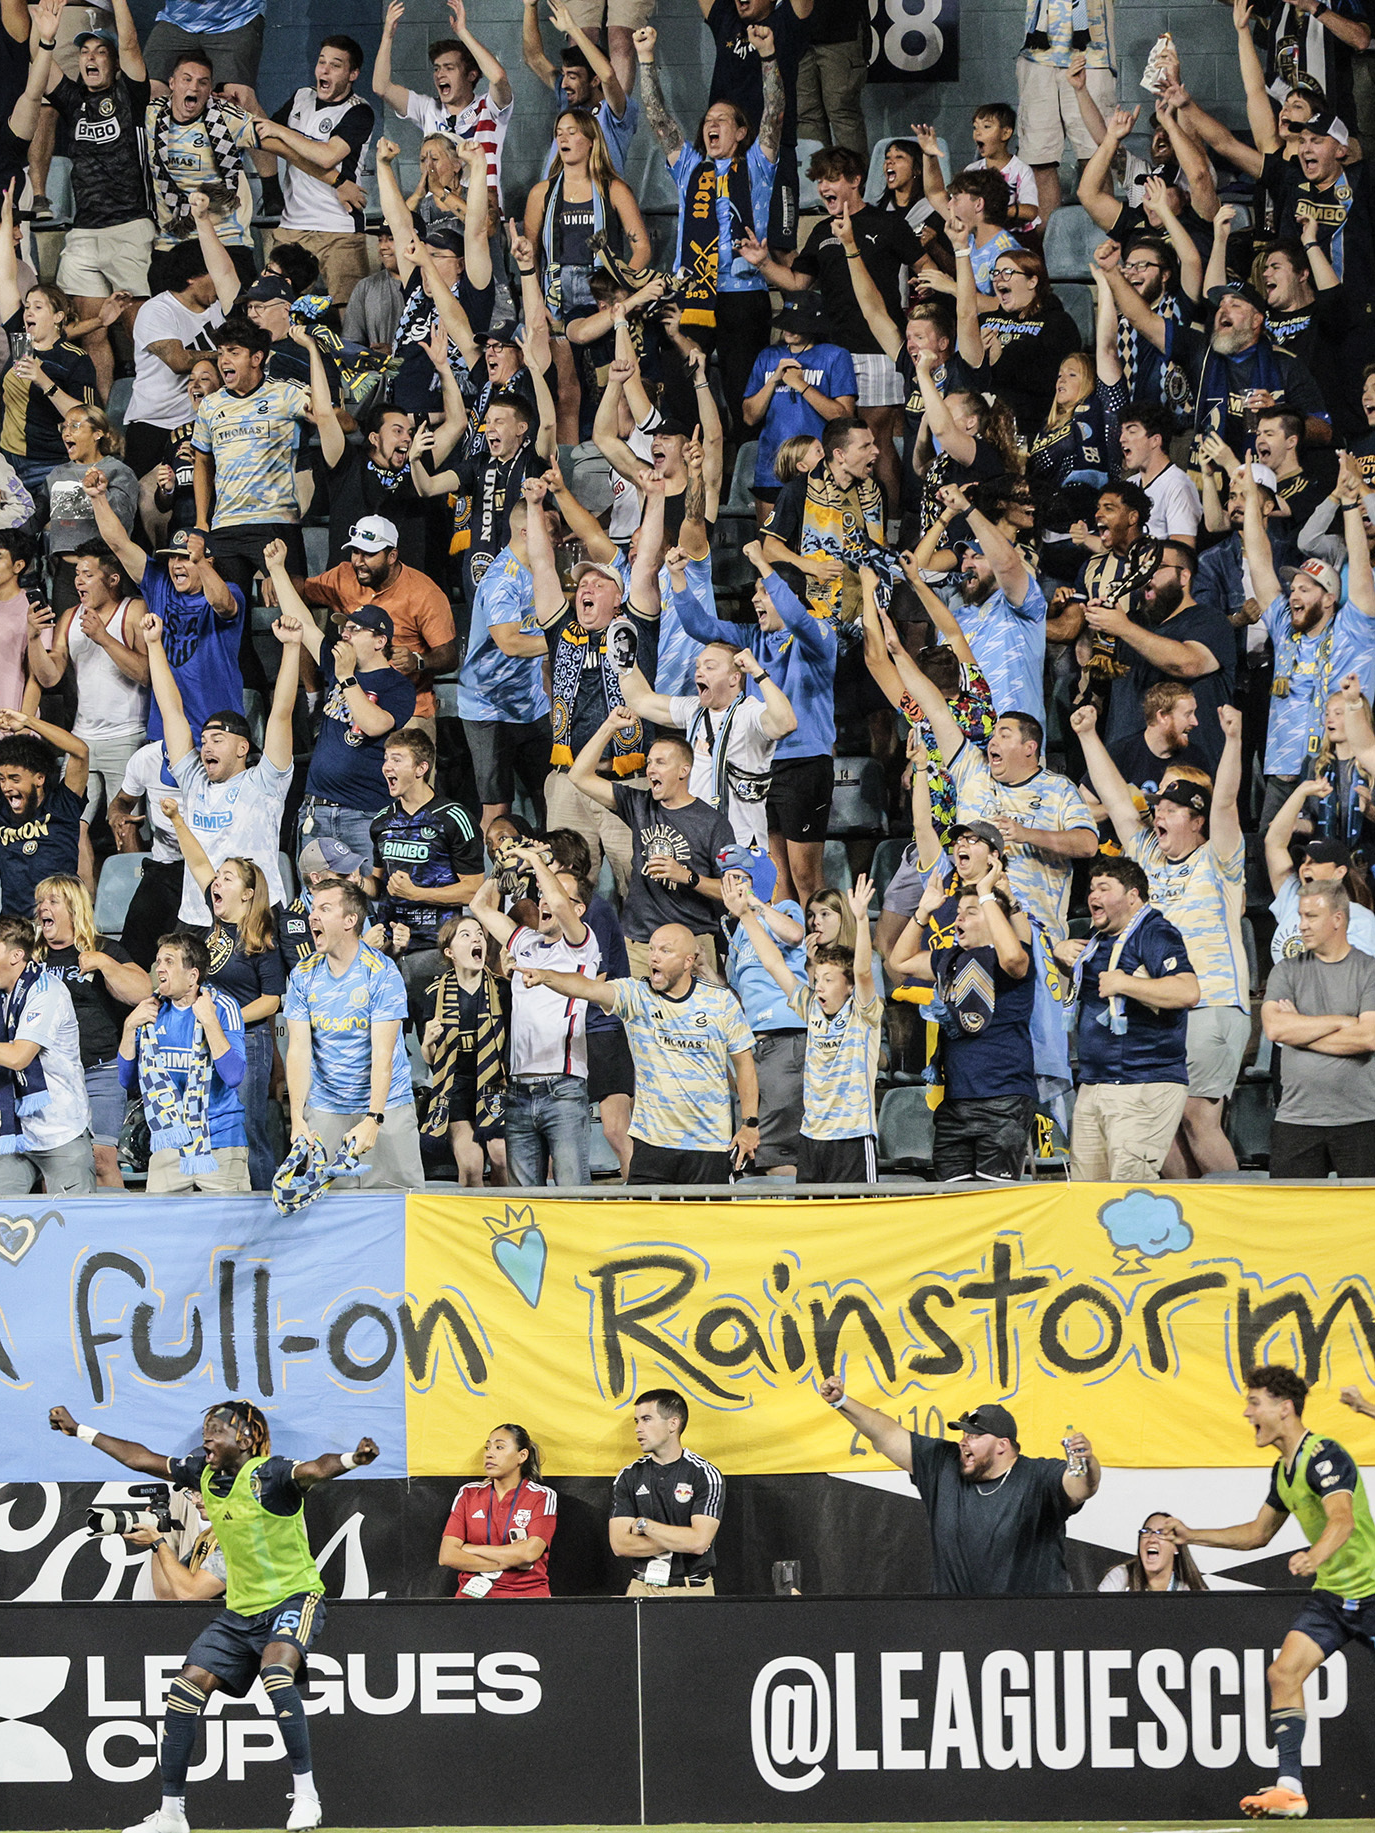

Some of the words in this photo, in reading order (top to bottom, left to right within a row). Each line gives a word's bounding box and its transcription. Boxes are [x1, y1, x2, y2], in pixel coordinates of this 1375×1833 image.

[564, 215, 595, 225] UNION
[480, 469, 497, 542] UNION
[383, 841, 430, 859] BIMBO
[74, 1251, 488, 1403] full-on
[587, 1241, 1375, 1402] Rainstorm
[272, 1610, 306, 1632] 15
[85, 1719, 288, 1783] CUP
[750, 1648, 1349, 1793] @LEAGUESCUP
